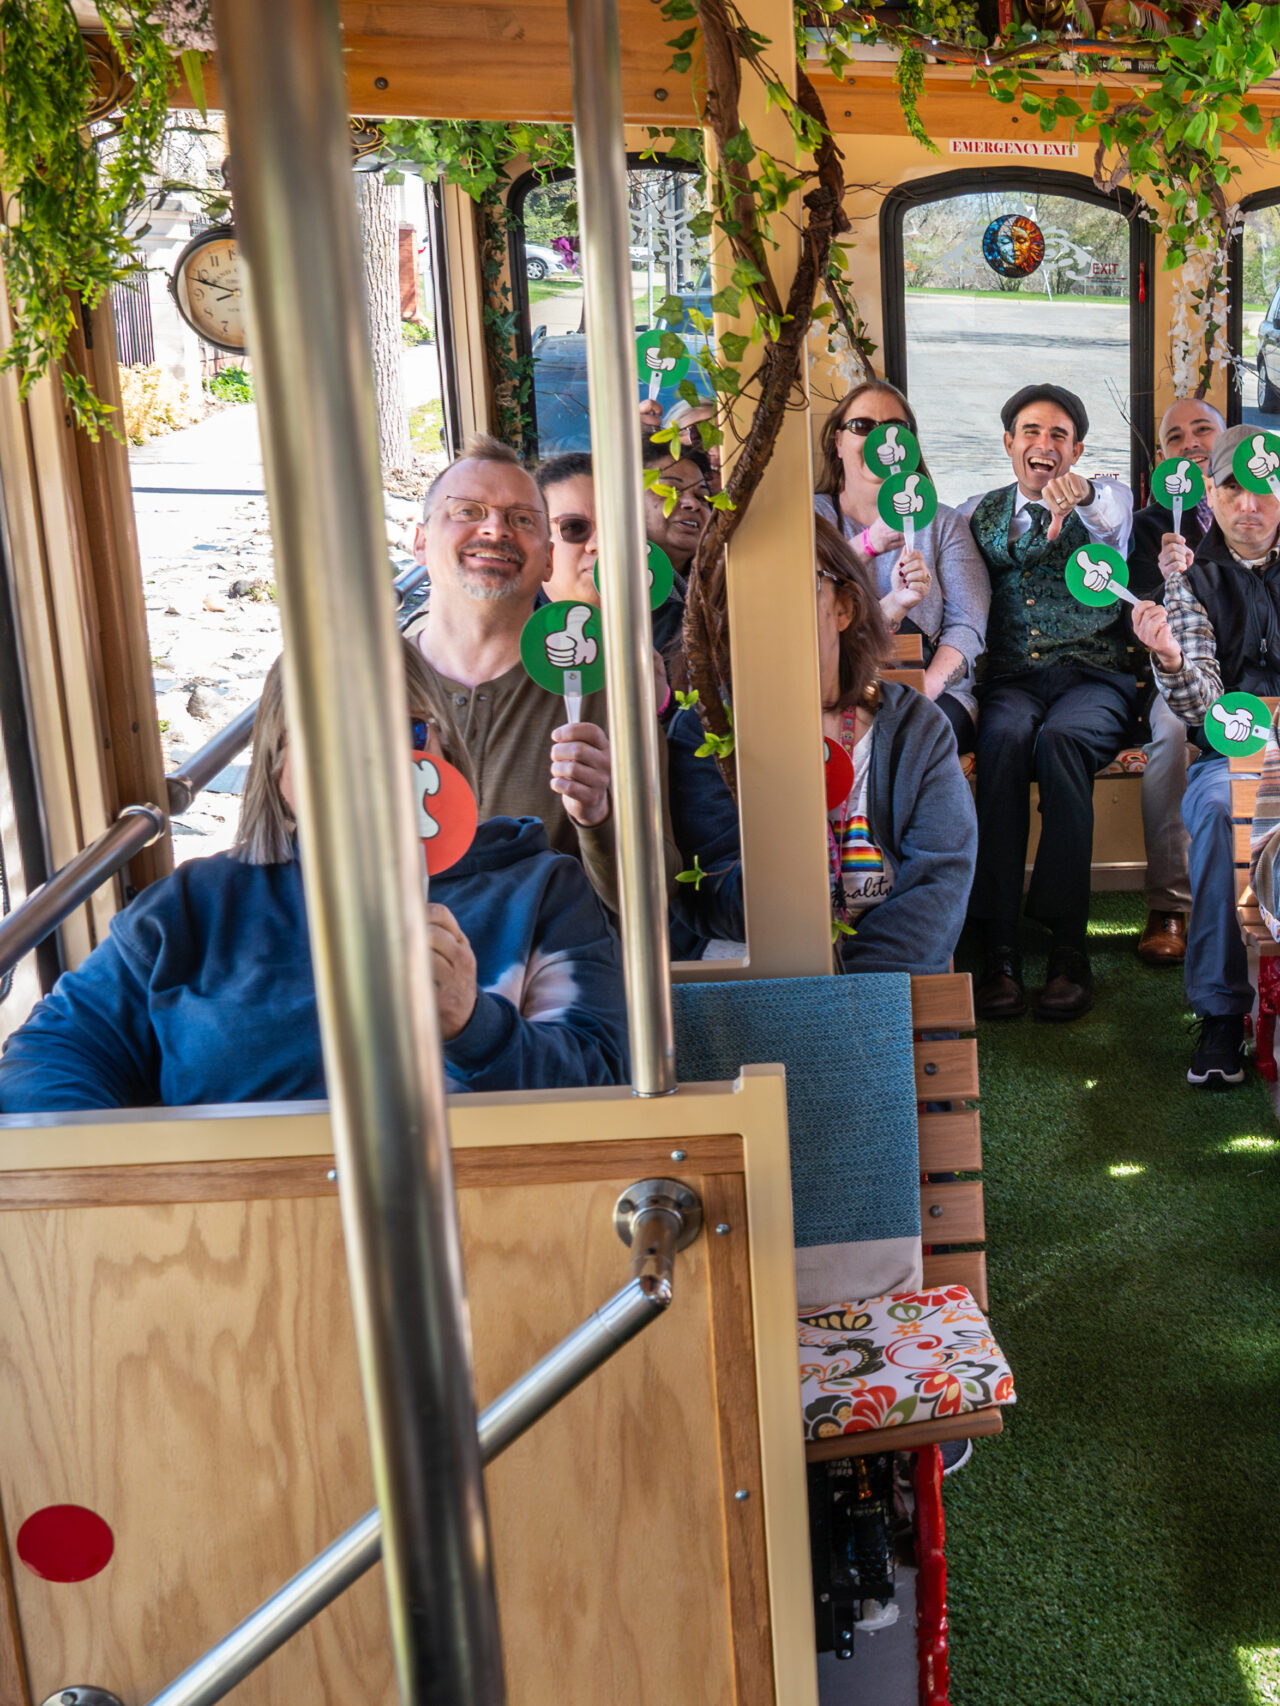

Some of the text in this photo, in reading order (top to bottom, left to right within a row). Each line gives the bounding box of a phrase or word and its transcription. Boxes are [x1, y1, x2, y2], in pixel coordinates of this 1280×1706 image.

[952, 141, 1076, 156] EMERGENCY EXIT
[1092, 262, 1119, 275] EXIT
